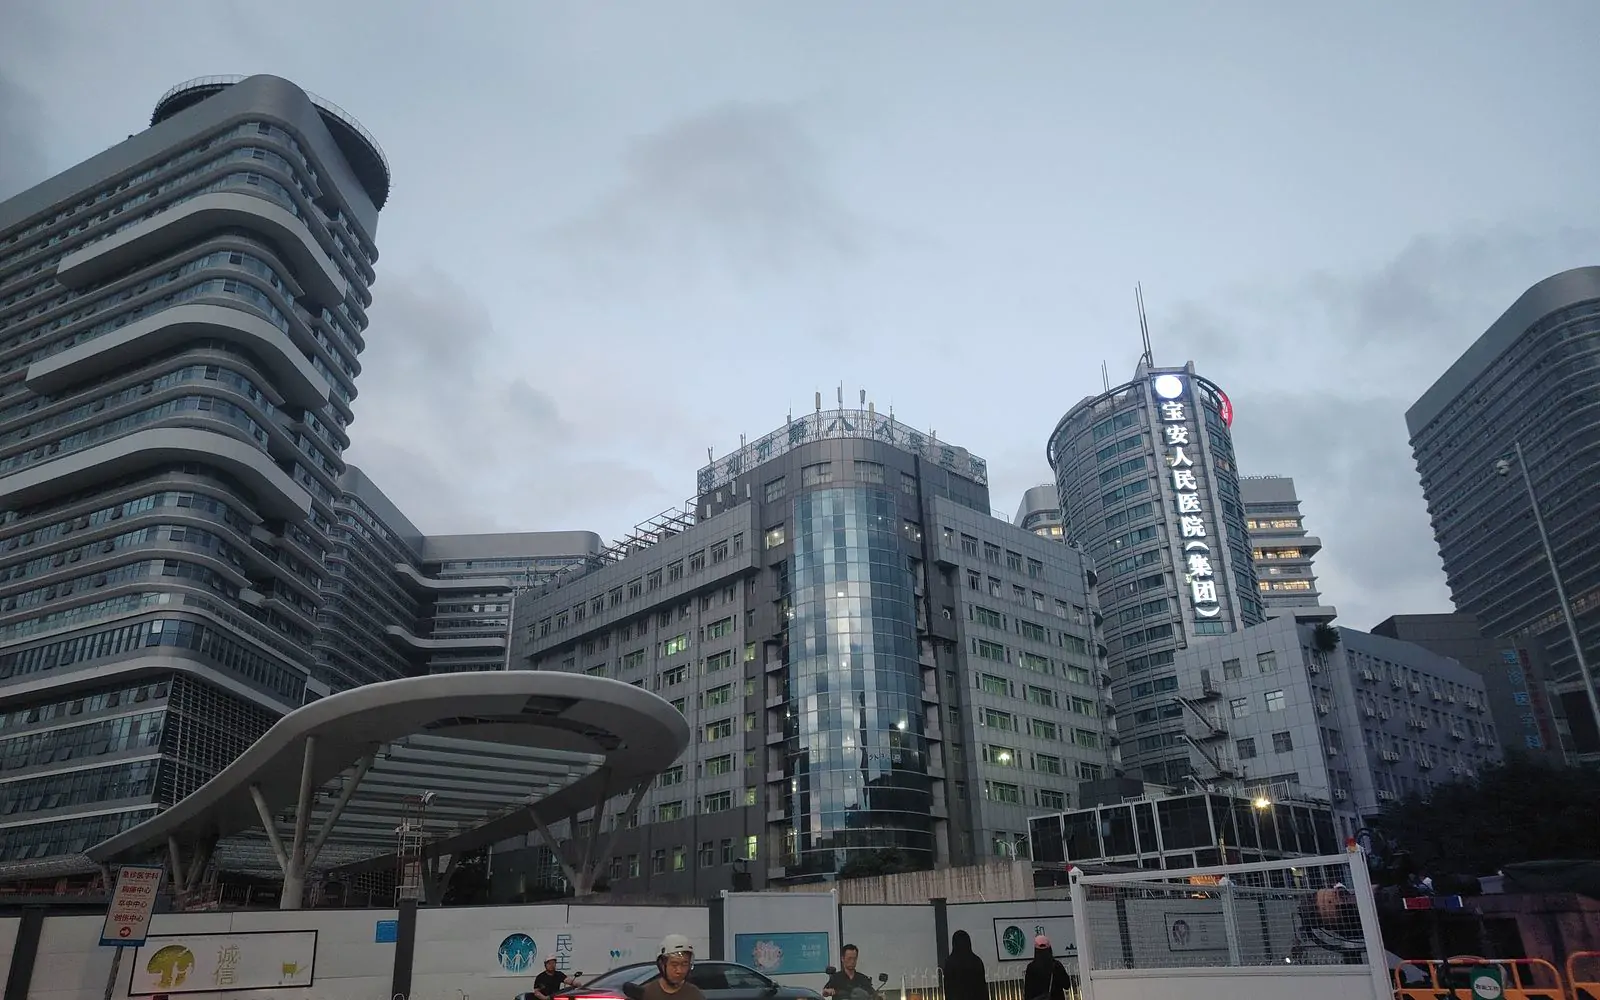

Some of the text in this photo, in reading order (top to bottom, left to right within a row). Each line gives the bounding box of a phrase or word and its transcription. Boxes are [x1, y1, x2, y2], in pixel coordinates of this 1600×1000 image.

[1161, 401, 1220, 617] 宝安人民医院（集团）
[213, 944, 241, 986] 诚信
[556, 934, 573, 971] 民主
